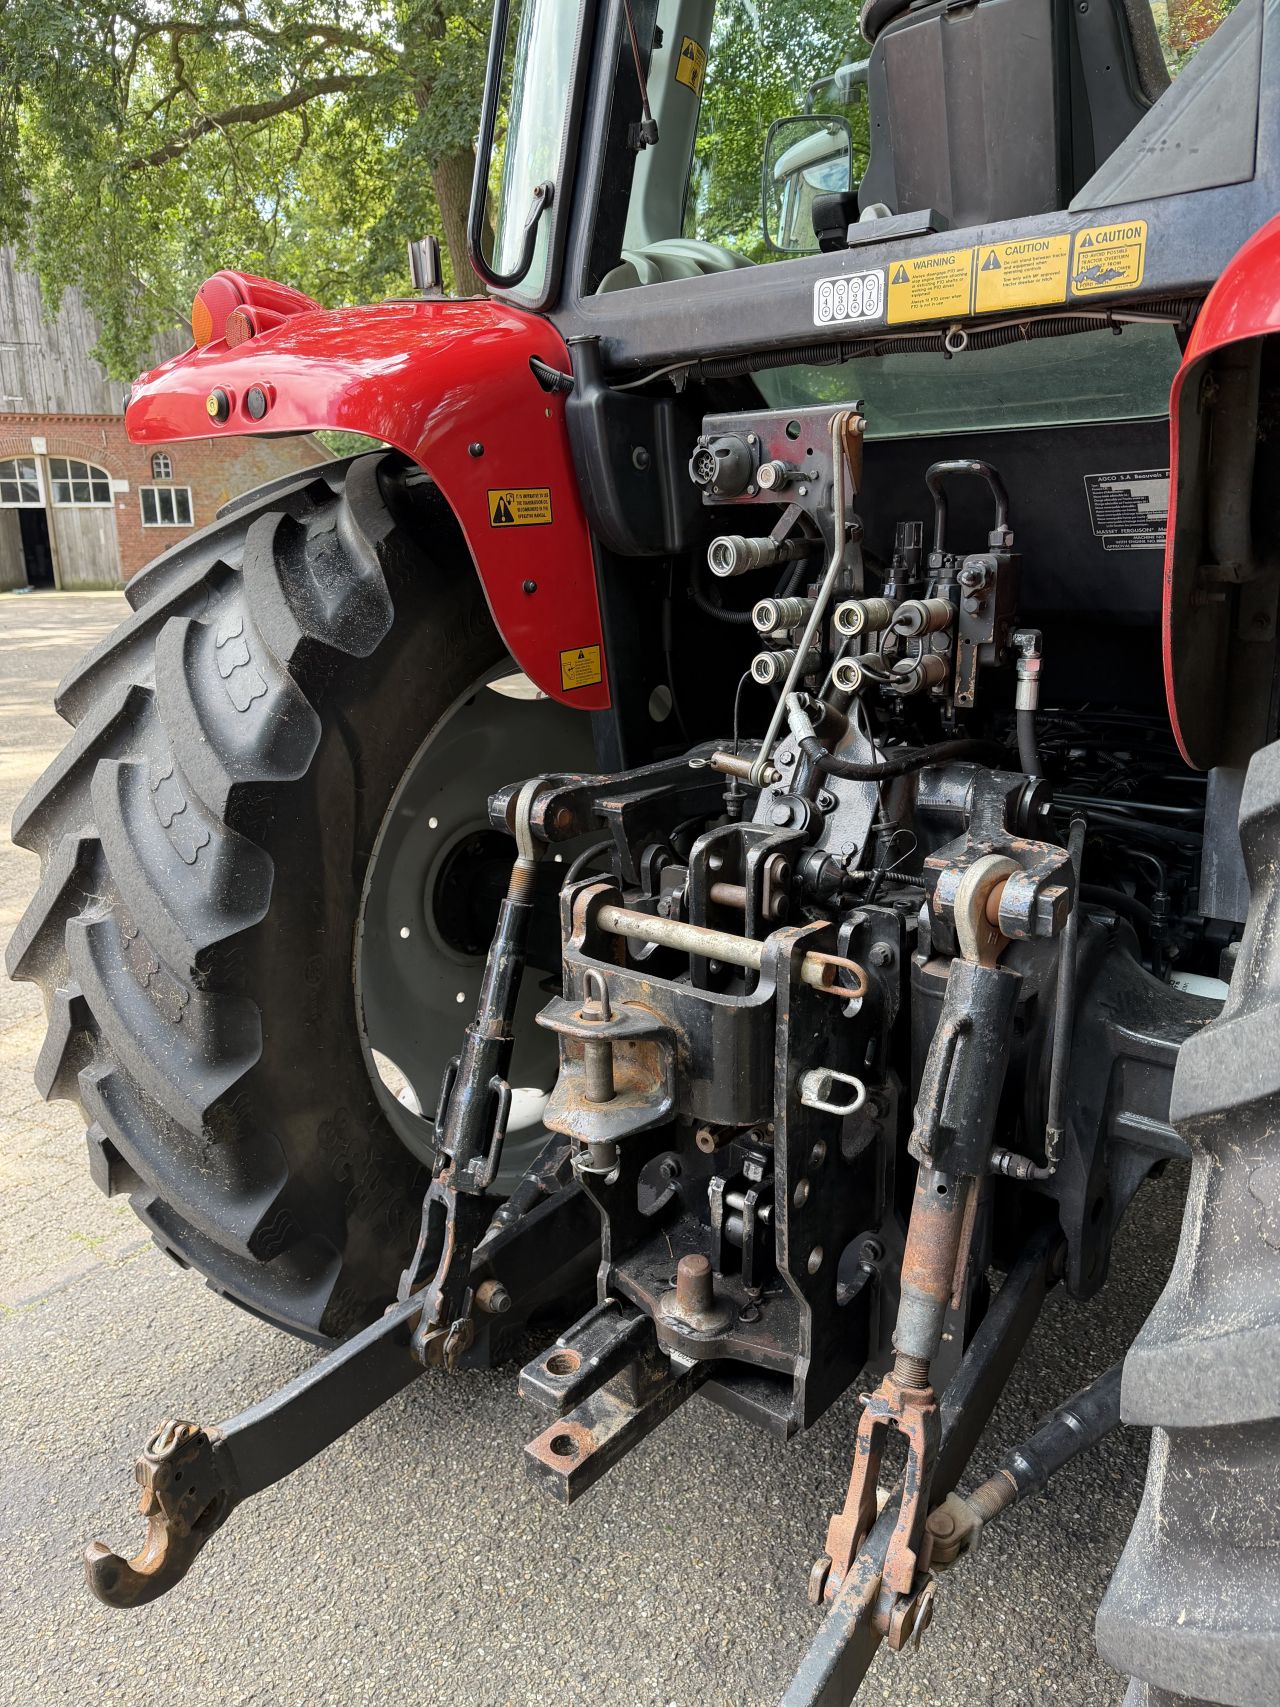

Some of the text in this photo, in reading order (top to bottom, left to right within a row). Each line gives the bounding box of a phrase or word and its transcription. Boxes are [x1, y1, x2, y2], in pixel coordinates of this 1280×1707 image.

[1096, 227, 1141, 244] CAUTION
[1005, 241, 1050, 255] CAUTION
[913, 256, 955, 270] WARNING
[838, 296, 843, 304] 3
[868, 291, 872, 299] 1
